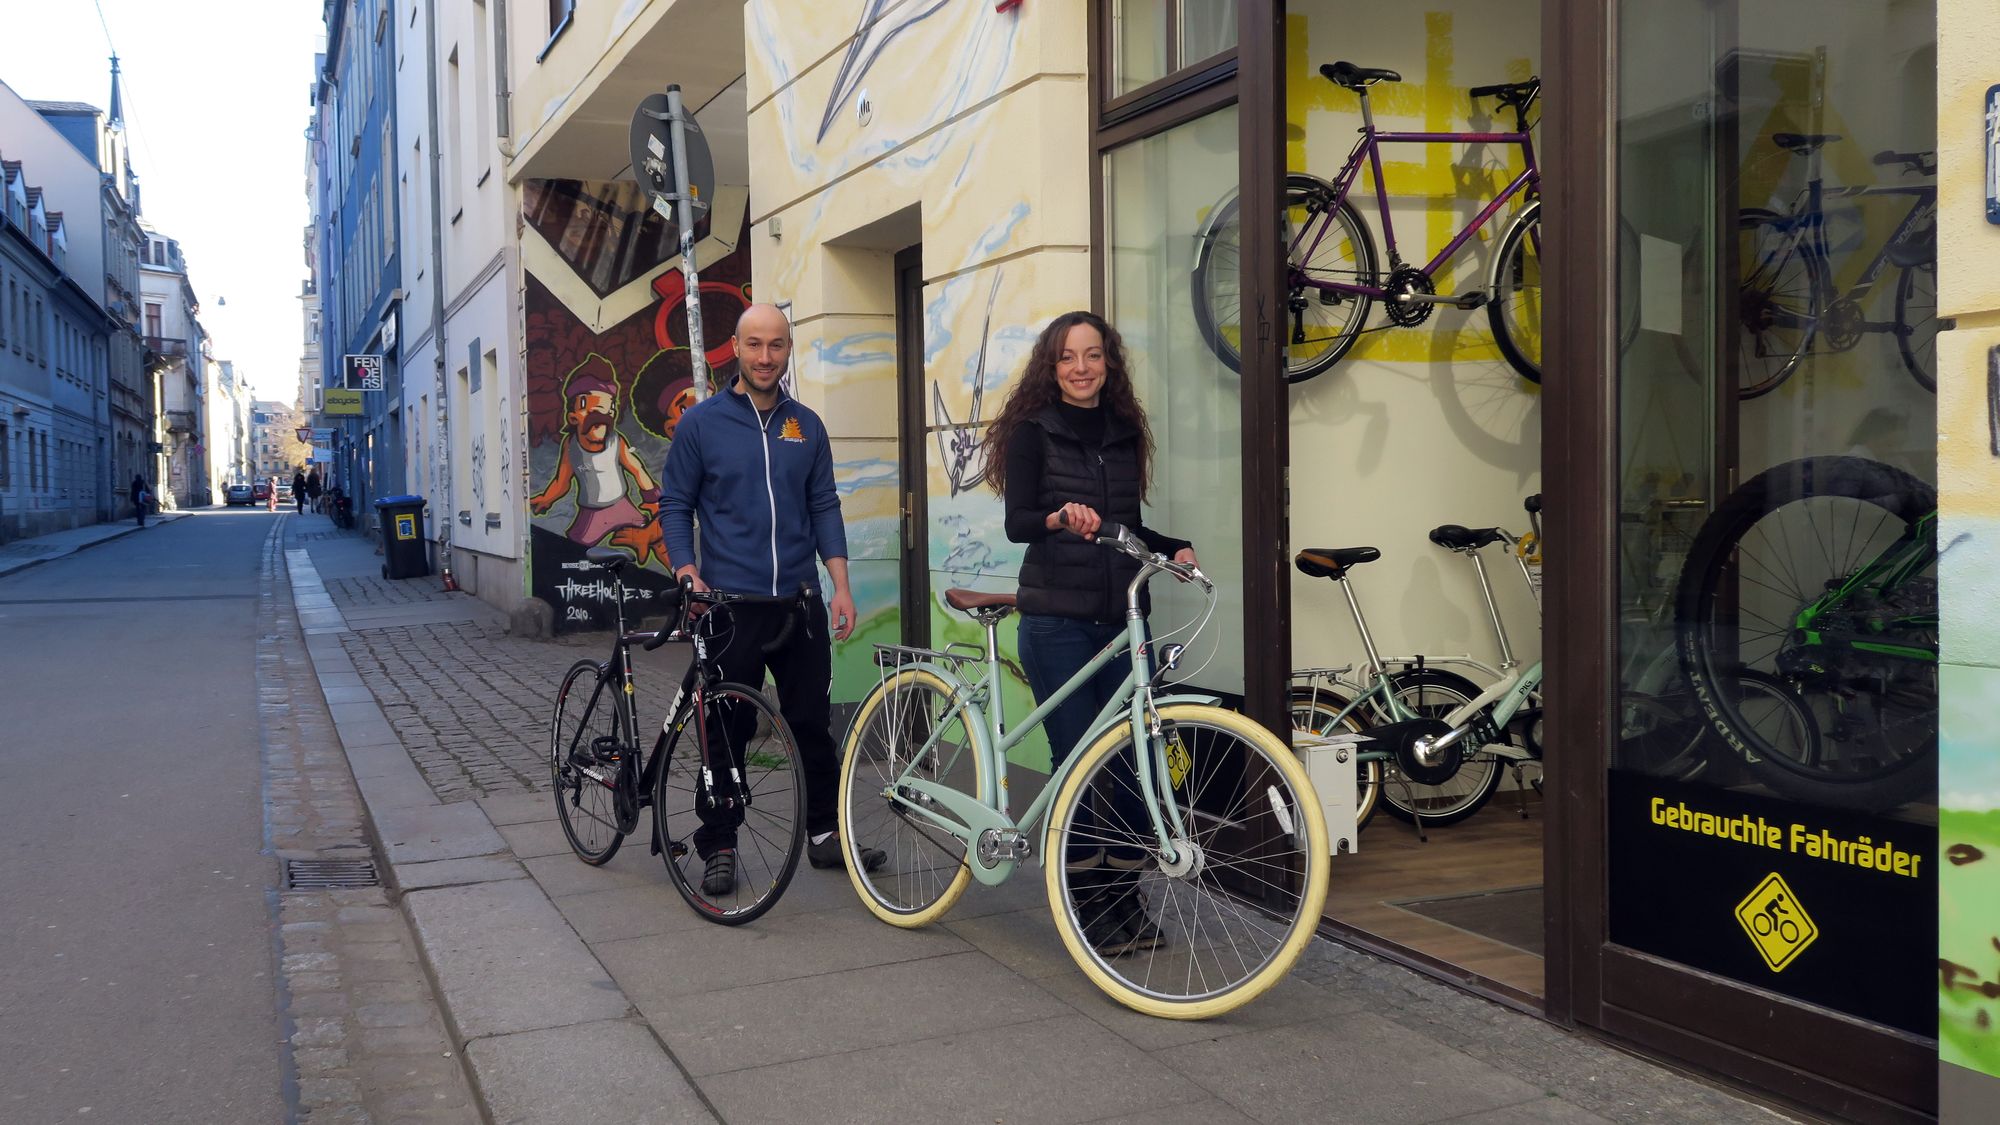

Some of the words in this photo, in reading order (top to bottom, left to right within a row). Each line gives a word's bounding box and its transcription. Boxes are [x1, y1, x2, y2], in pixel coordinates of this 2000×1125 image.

[354, 358, 379, 367] FEN
[362, 379, 380, 388] RS
[554, 577, 653, 604] THREEHOUE.DE
[1690, 671, 1762, 763] ARDENT
[1651, 797, 1781, 849] Gebrauchte
[1790, 823, 1921, 877] Fahrräder
